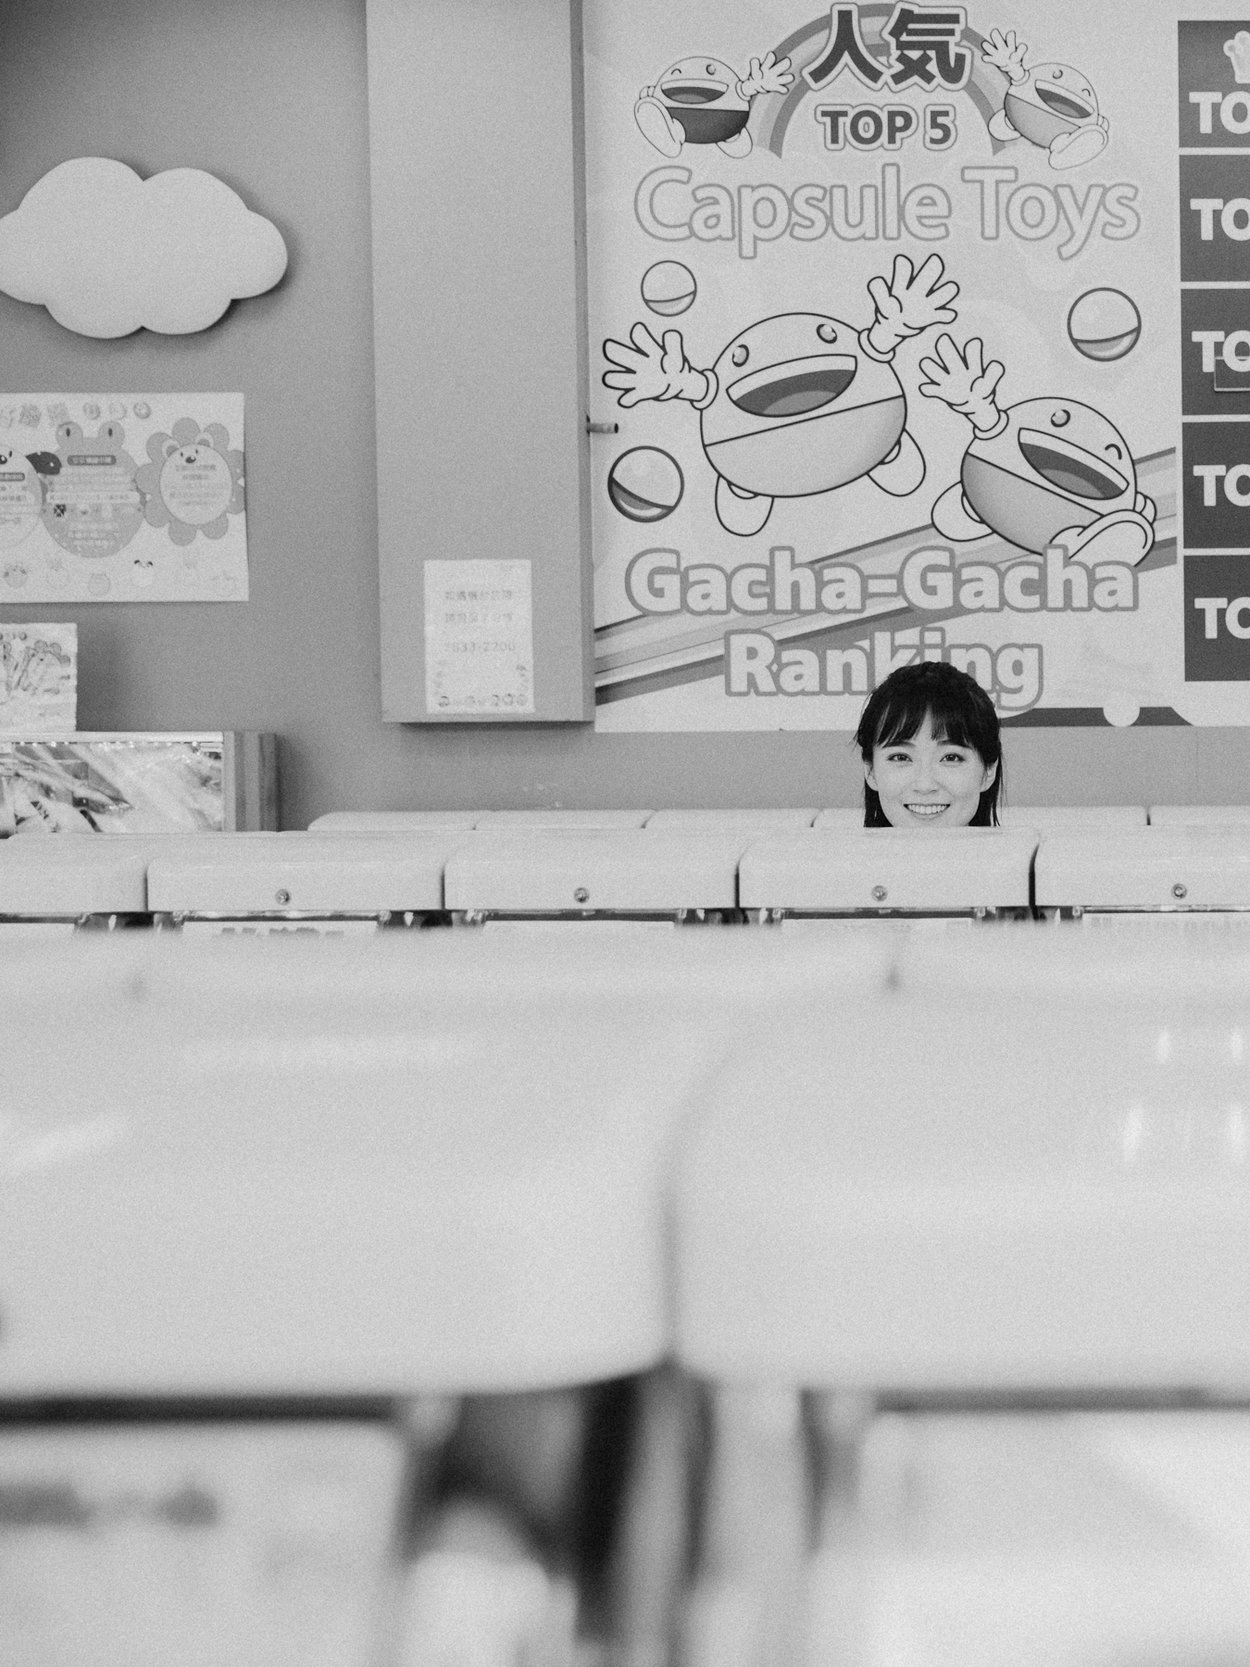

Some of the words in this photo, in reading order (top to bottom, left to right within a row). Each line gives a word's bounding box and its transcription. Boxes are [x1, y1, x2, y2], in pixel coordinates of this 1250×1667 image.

[805, 6, 970, 89] 人気
[820, 109, 914, 146] TOP
[929, 109, 952, 146] 5
[633, 162, 953, 260] Capsule
[962, 164, 1142, 261] Toys
[624, 544, 1140, 616] Gacha-Gacha
